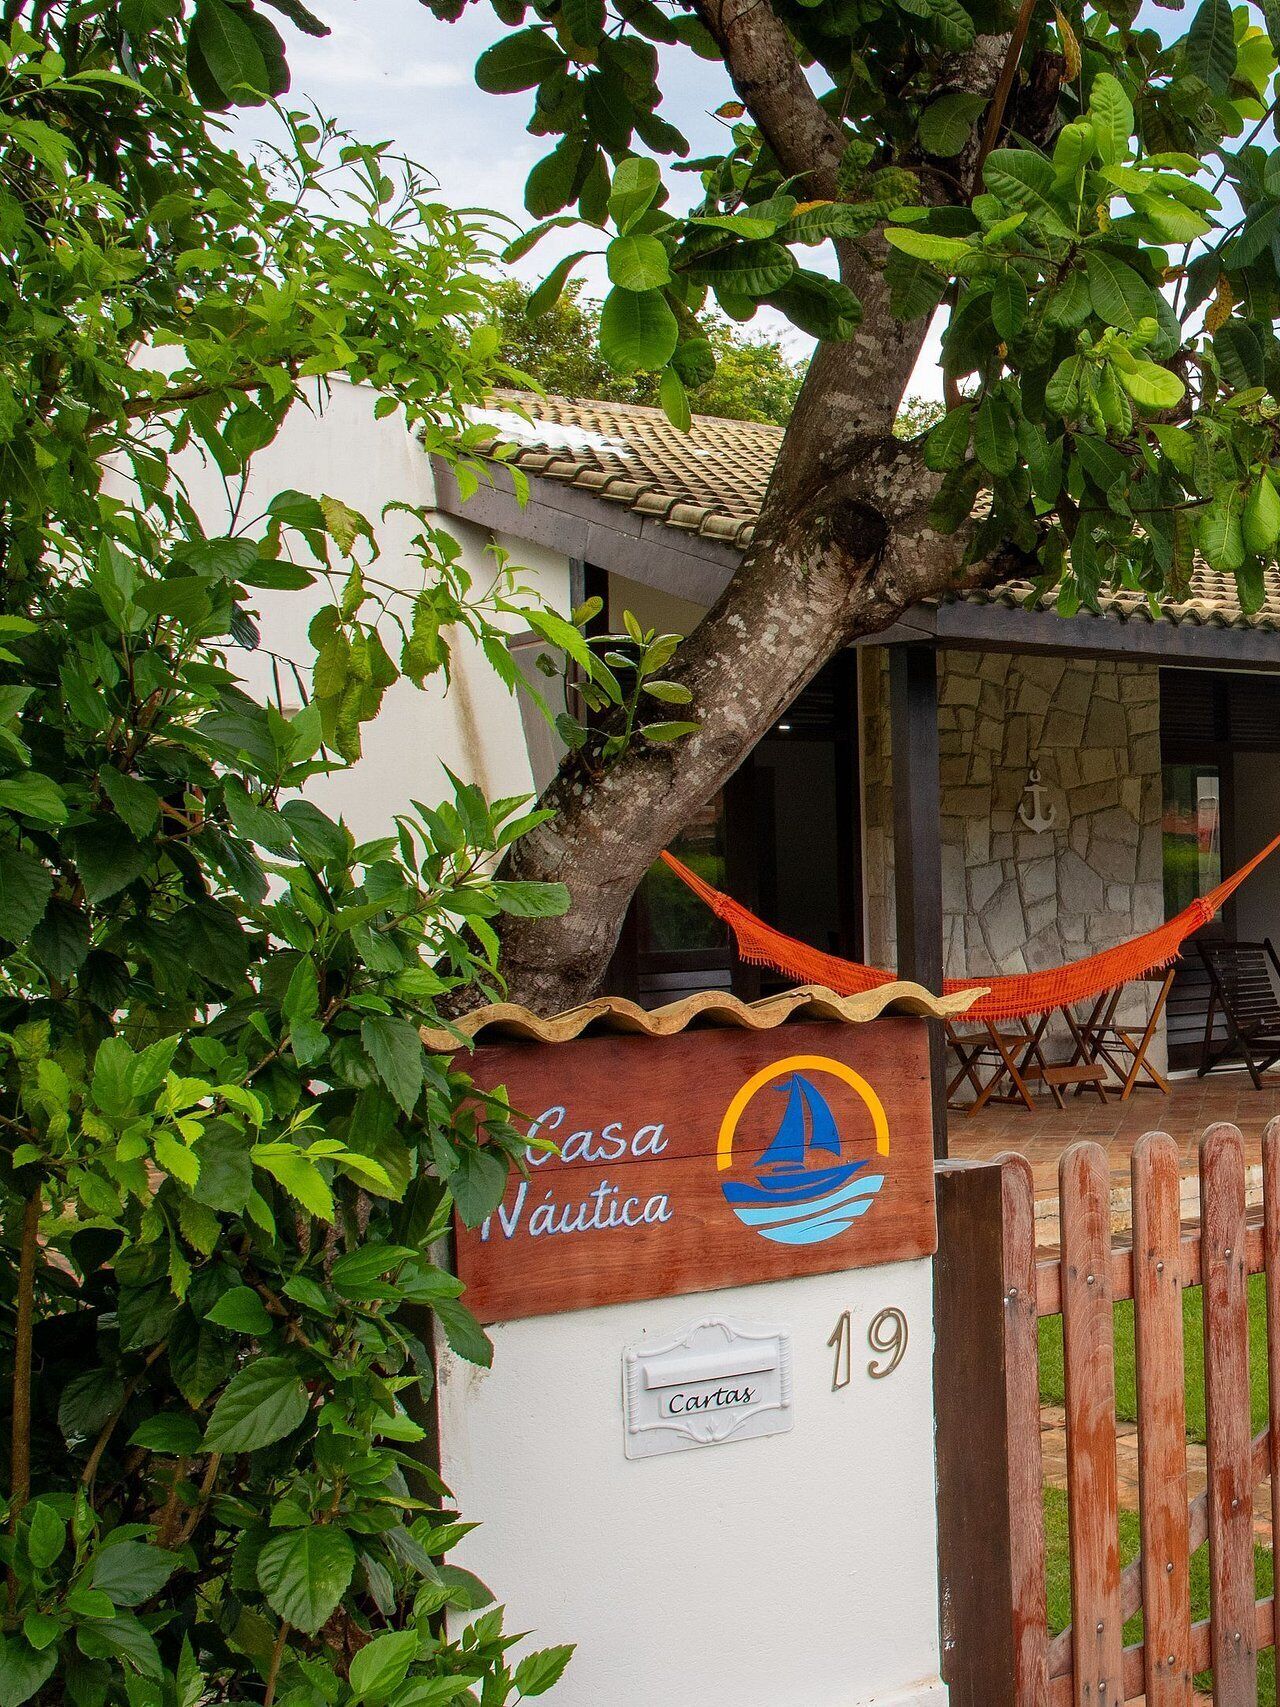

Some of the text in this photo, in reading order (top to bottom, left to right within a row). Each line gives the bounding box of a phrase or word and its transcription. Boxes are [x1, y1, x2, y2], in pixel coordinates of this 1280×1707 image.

[524, 1105, 669, 1166] Casa
[480, 1179, 673, 1242] Náutica
[827, 1306, 909, 1392] 19
[668, 1384, 757, 1414] Cartas
